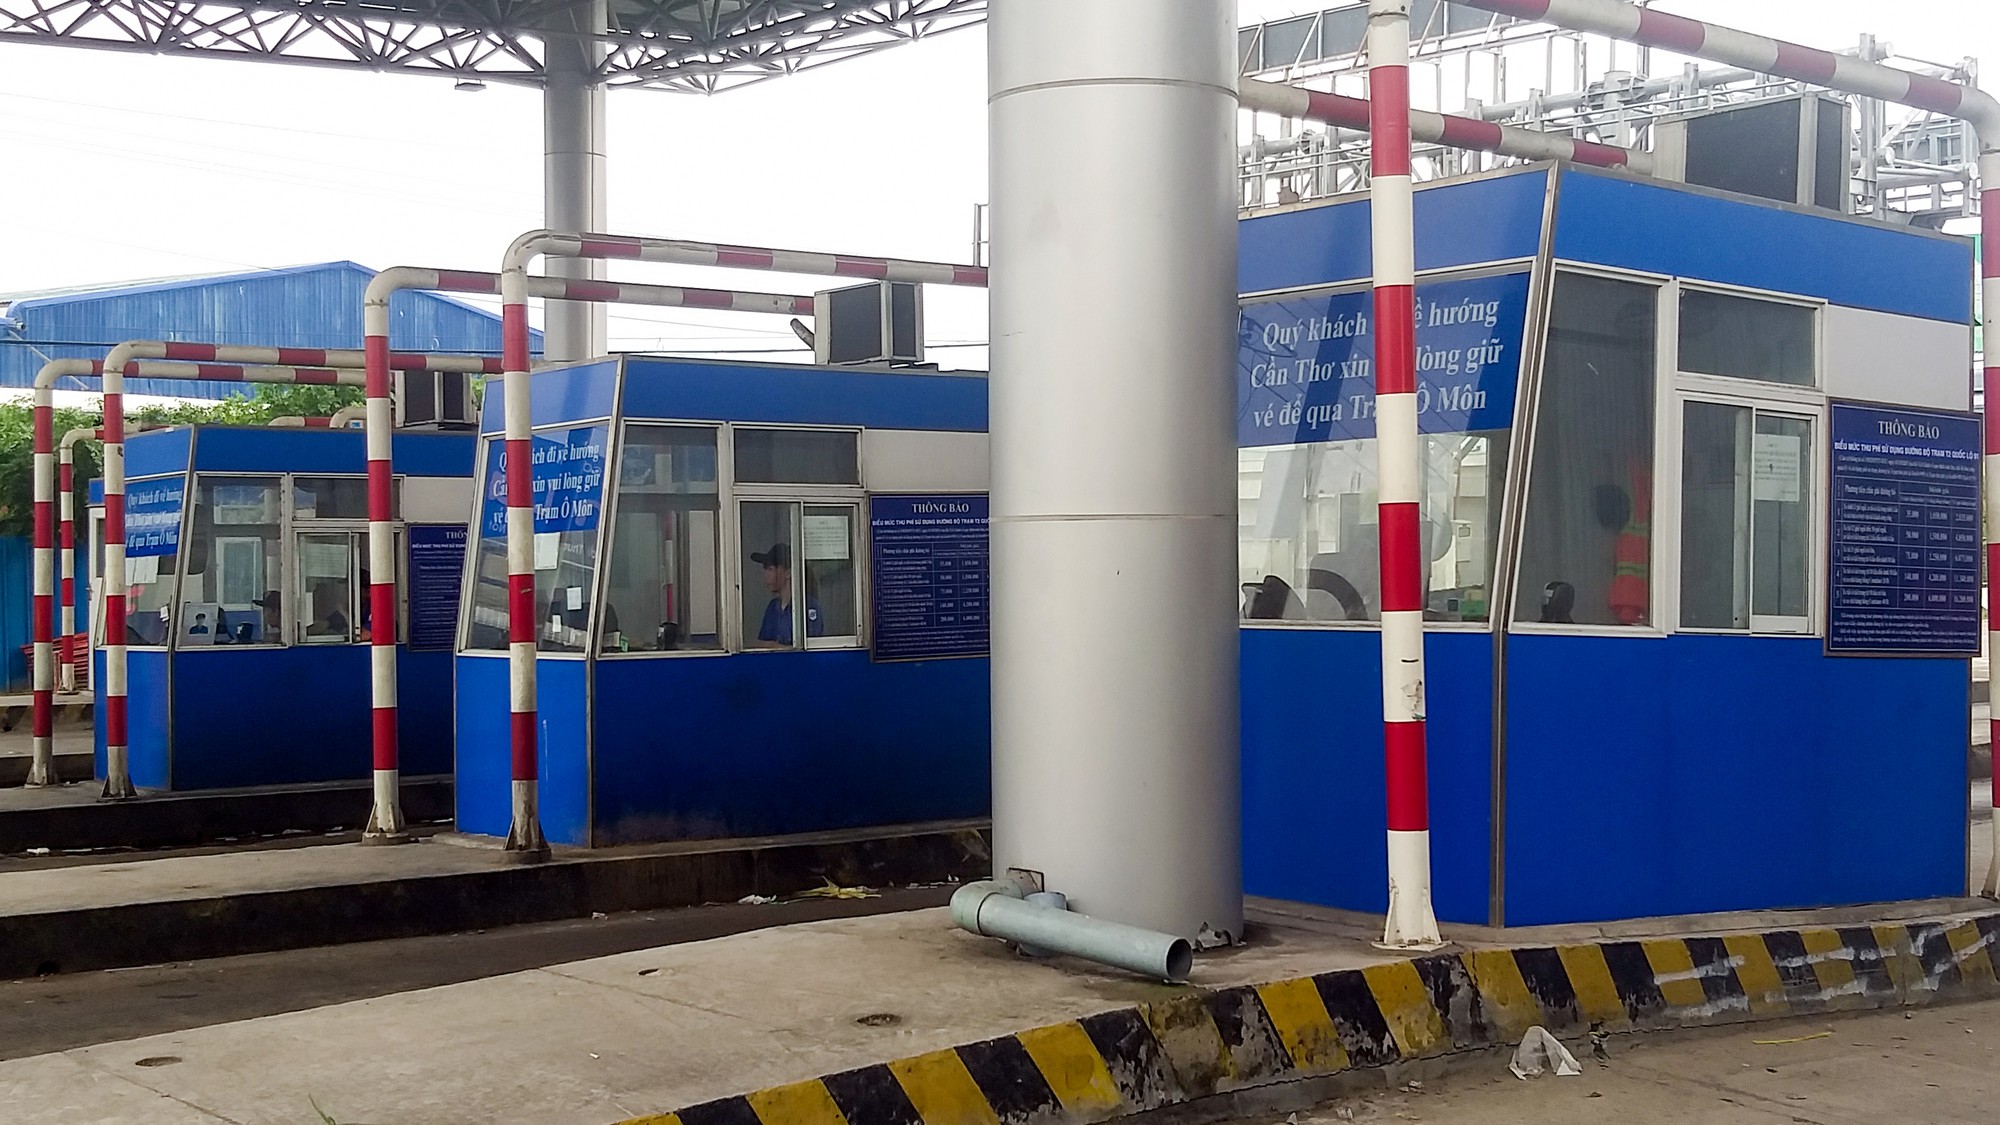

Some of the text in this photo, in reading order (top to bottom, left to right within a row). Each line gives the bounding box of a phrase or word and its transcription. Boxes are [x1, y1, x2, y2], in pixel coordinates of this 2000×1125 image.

[1263, 318, 1303, 352] Quý
[1307, 312, 1367, 342] khách
[1428, 297, 1500, 328] hướng
[1251, 337, 1504, 388] Cần Thơ xin lòng giữ
[1253, 381, 1487, 430] vé để qua Tr Ô Môn
[1878, 418, 1940, 440] THÔNG BÁO
[546, 445, 557, 463] đi
[570, 441, 599, 462] hướng
[547, 473, 562, 491] vui
[563, 472, 583, 493] lòng
[584, 469, 601, 492] giữ
[494, 507, 504, 524] vé
[535, 504, 559, 524] Trạm
[561, 496, 570, 518] Ô
[571, 499, 593, 517] Môn
[911, 500, 969, 513] THÔNG BÁO
